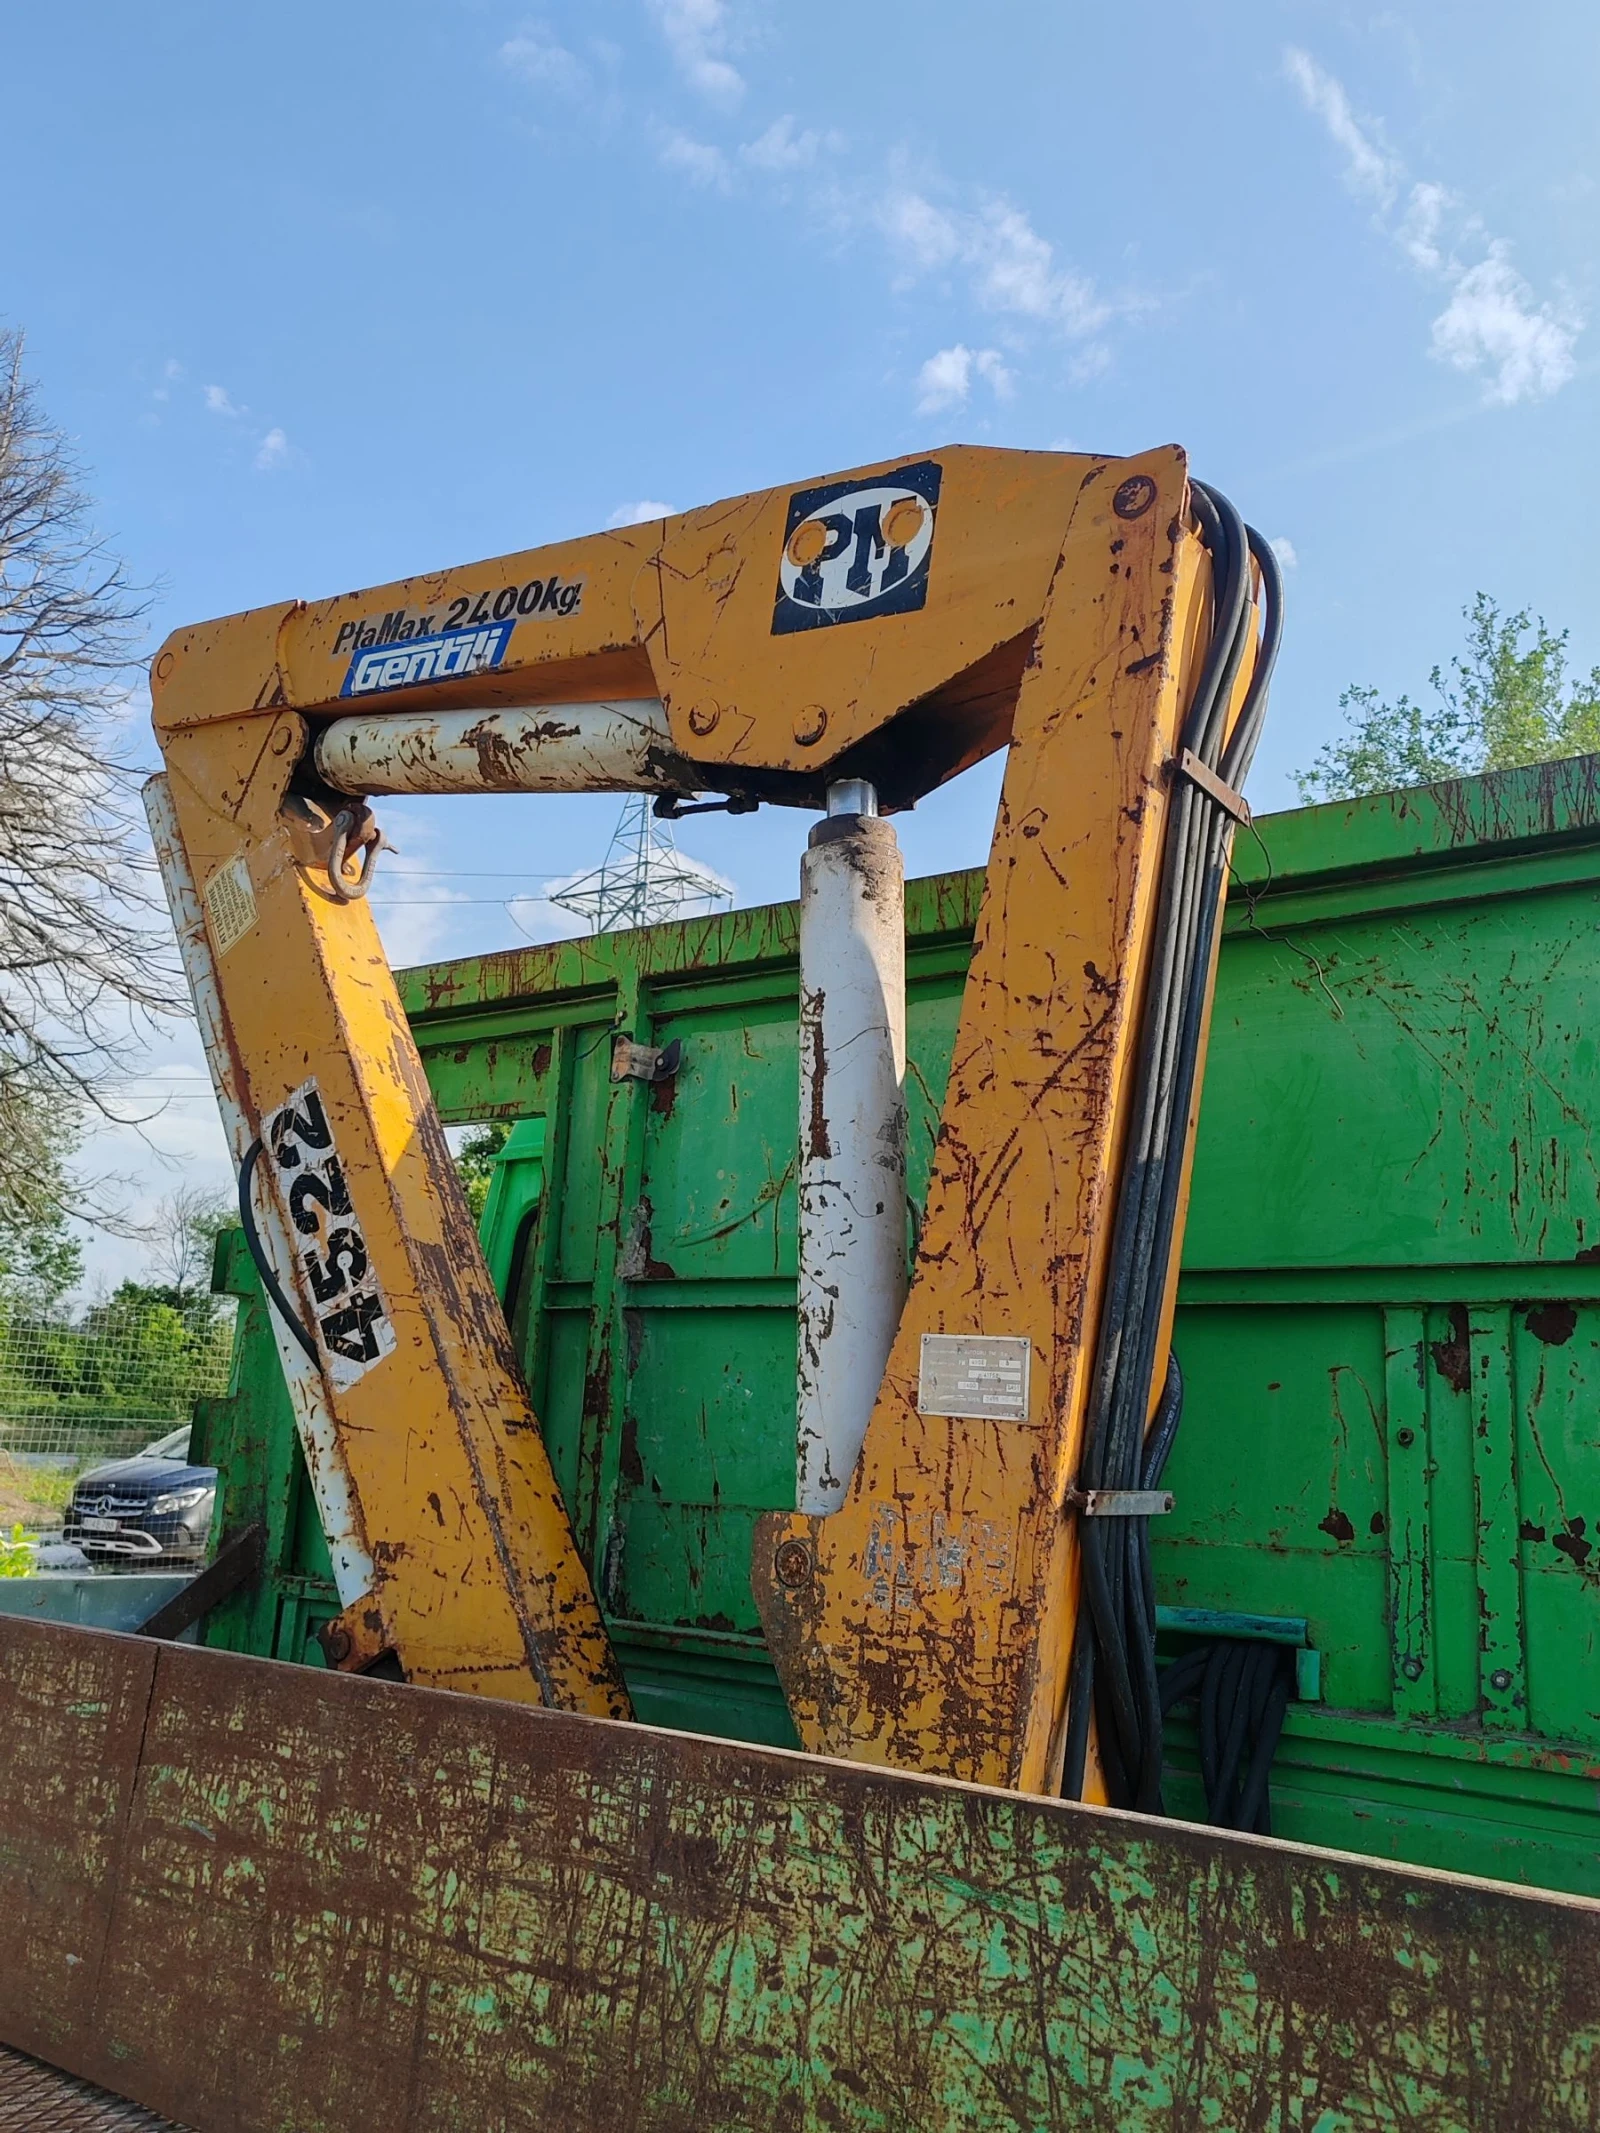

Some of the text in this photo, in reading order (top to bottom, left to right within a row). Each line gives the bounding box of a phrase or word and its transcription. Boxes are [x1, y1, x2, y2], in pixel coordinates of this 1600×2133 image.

[351, 627, 503, 695] Gentili
[208, 884, 227, 946] ATTENZIONE
[271, 1089, 384, 1364] 4522
